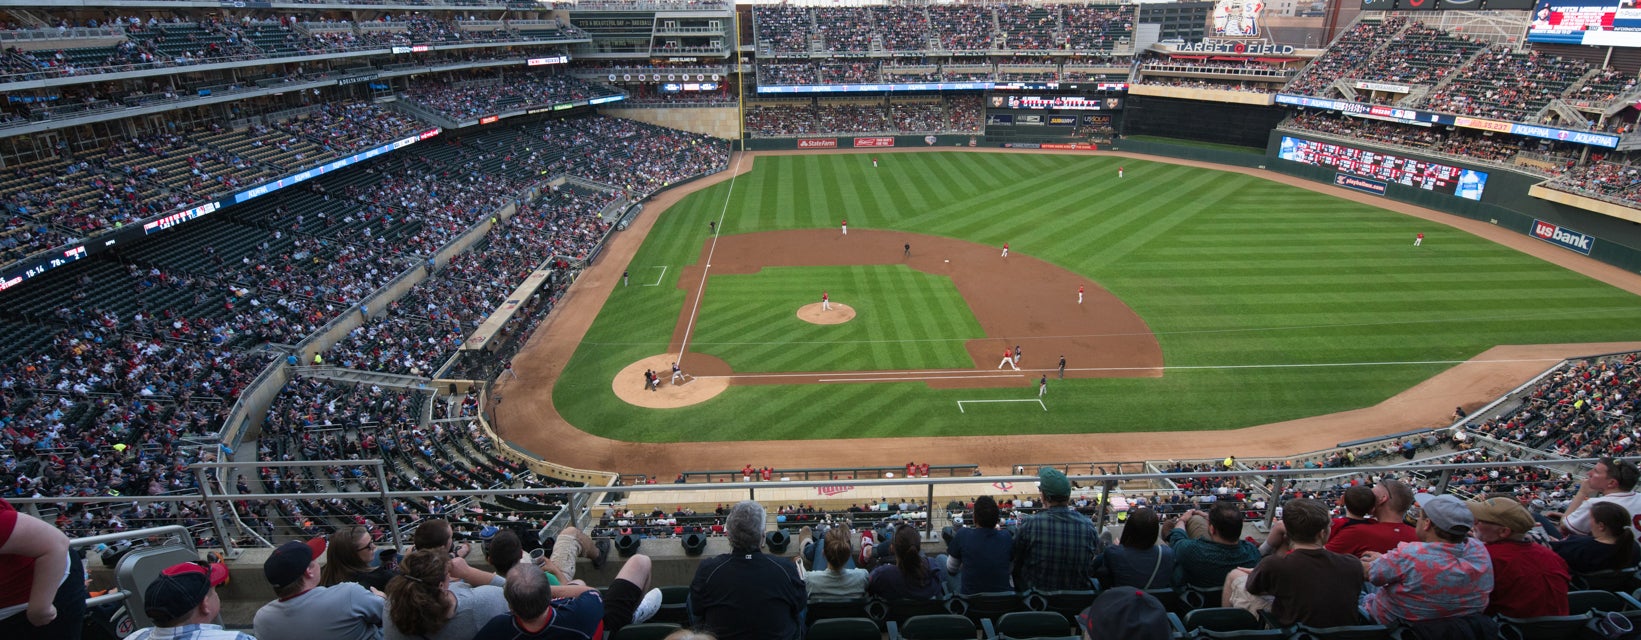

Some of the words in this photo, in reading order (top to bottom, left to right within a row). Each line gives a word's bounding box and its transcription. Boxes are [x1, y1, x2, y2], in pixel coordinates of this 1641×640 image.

[1176, 42, 1233, 53] TARGET
[1247, 44, 1294, 54] FIELD
[1515, 124, 1549, 137] AQUAFINA
[1573, 133, 1612, 145] AQUAFINA
